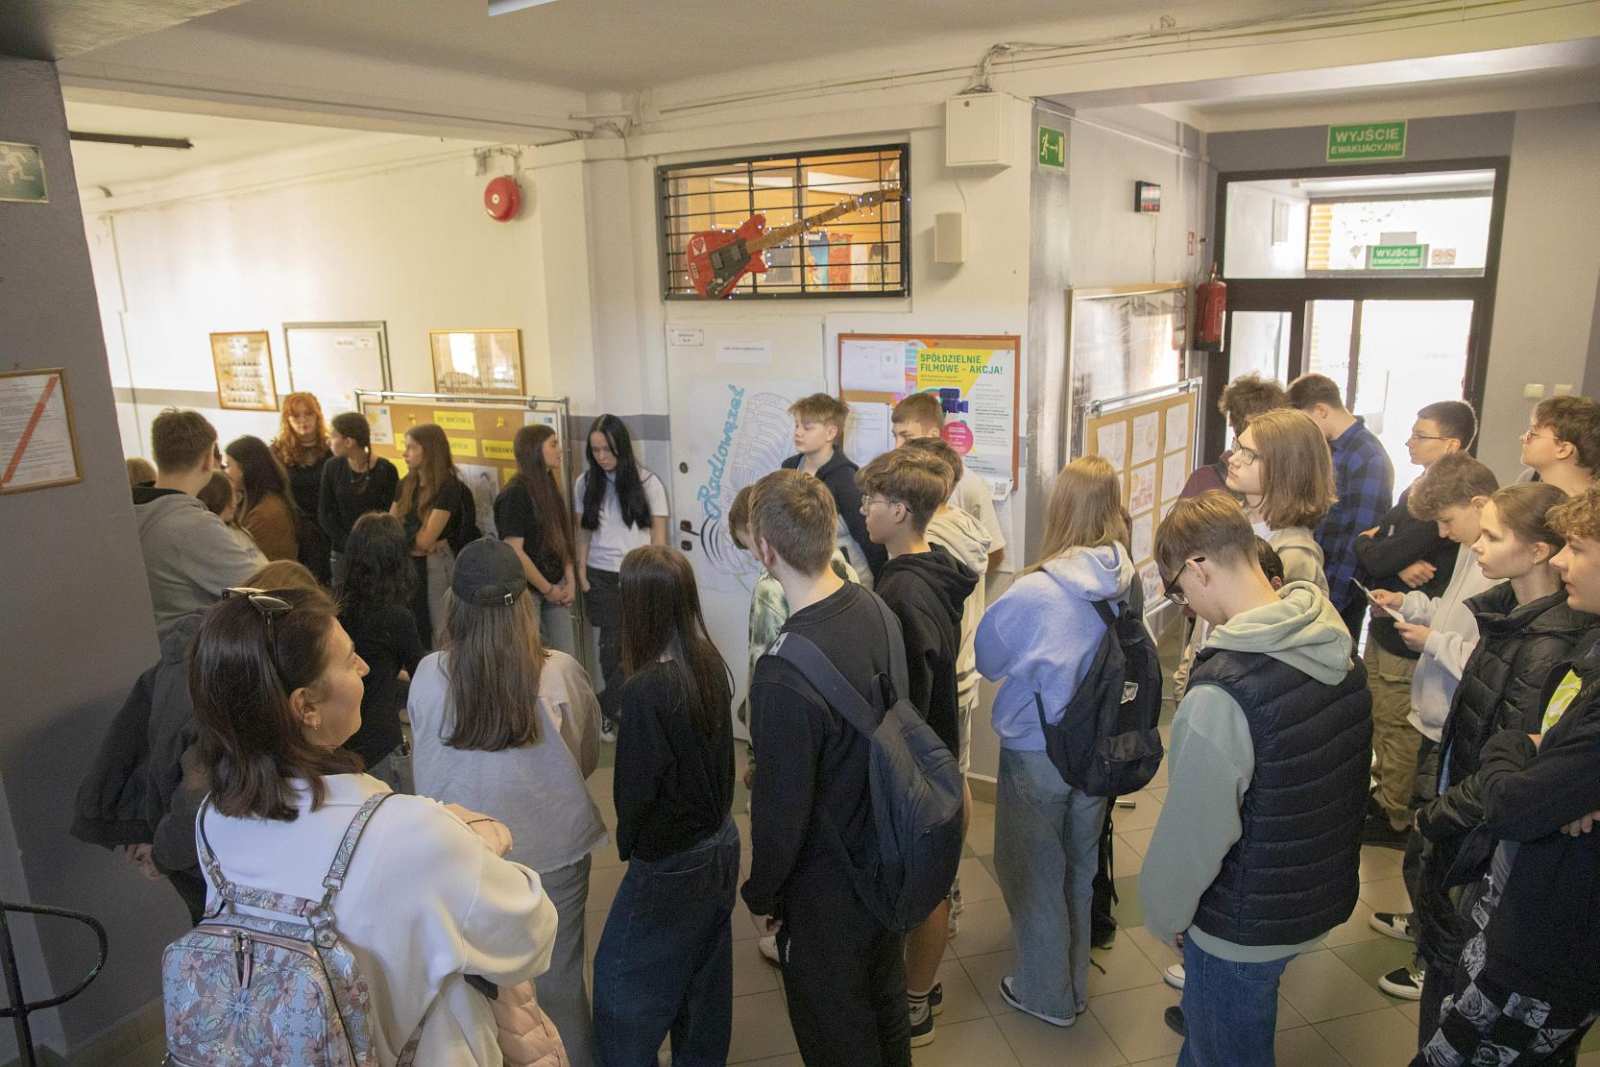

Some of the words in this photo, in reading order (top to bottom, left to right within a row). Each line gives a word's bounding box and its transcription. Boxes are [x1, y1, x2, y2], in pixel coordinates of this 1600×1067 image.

[1335, 127, 1400, 142] WYJŚCIE
[920, 352, 982, 364] SPÓŁDZIELNIE
[920, 363, 960, 373] FILMOWE
[969, 365, 1003, 374] AKCJA!
